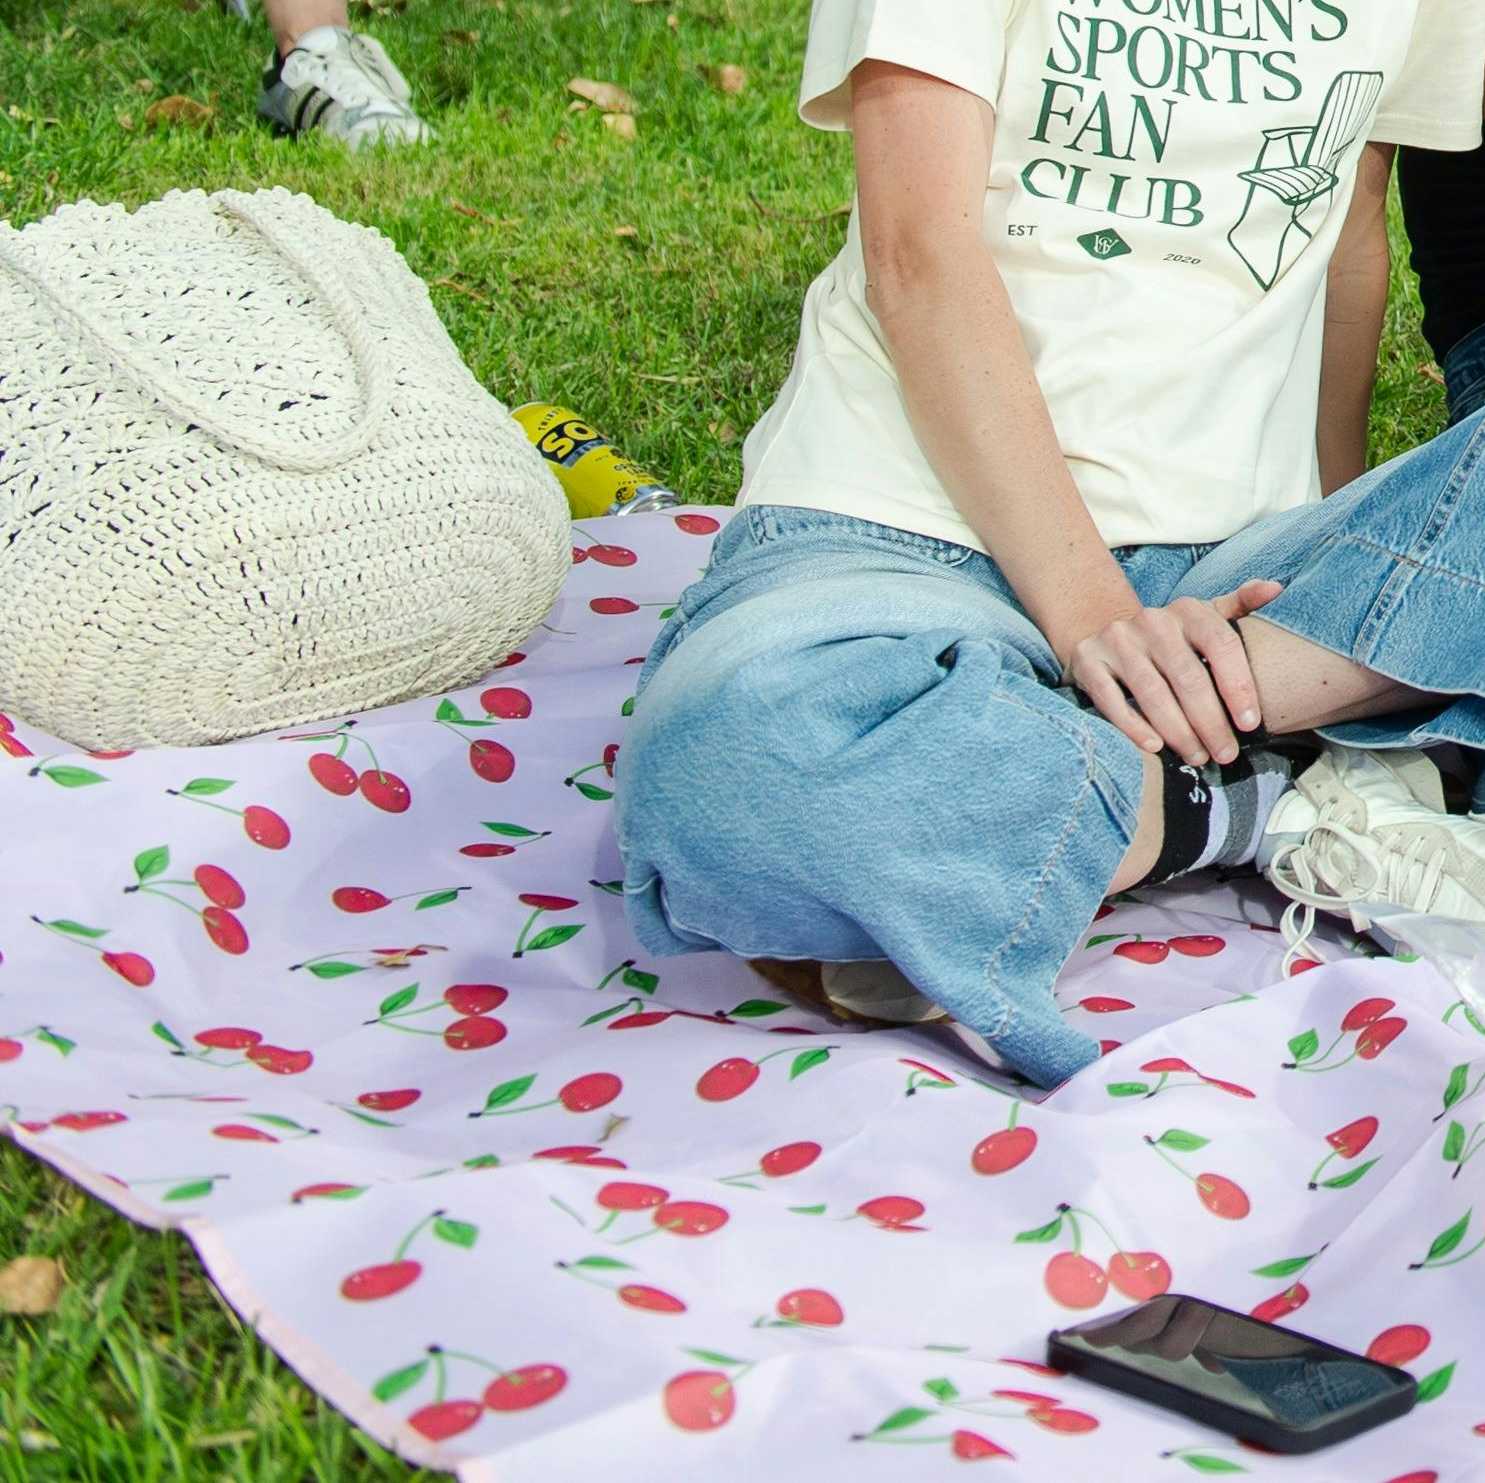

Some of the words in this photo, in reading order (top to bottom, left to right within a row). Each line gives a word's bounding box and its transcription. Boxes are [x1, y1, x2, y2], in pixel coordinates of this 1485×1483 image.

[1046, 11, 1302, 104] SPORTS
[1028, 78, 1177, 164] FAN
[1021, 158, 1205, 228] CLUB
[1008, 224, 1038, 237] EST
[1162, 252, 1202, 266] 2020
